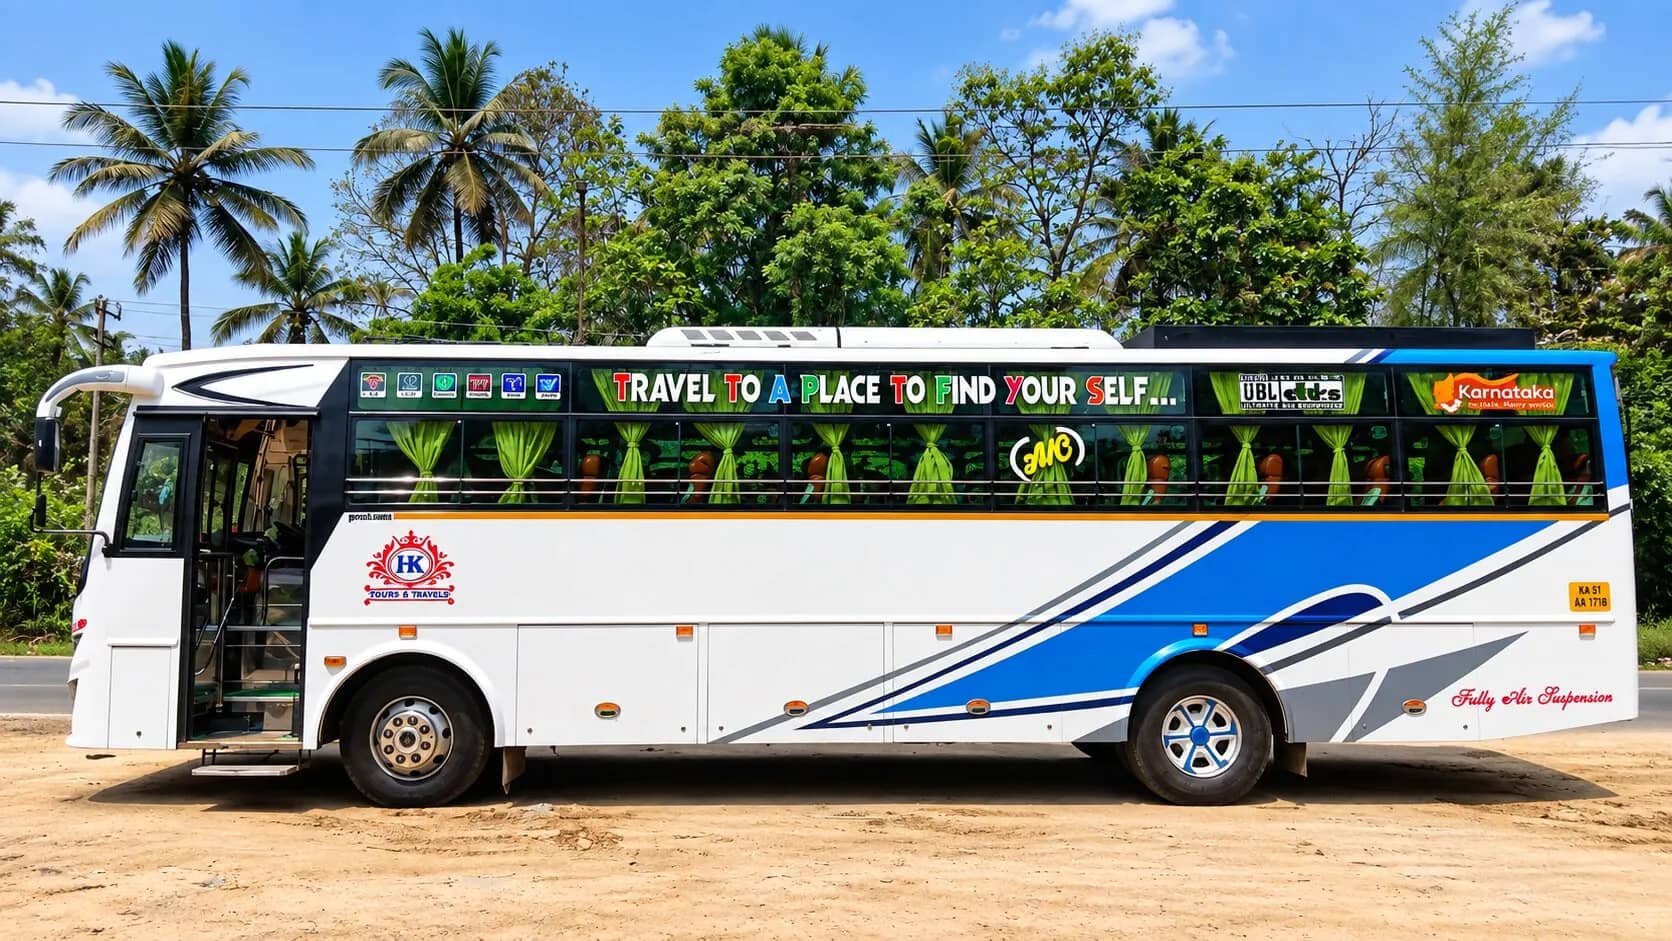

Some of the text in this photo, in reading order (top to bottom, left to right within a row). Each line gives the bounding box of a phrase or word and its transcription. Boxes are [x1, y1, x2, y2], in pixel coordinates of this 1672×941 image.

[613, 372, 716, 403] TRAVEL
[724, 374, 761, 404] TO
[768, 374, 792, 404] A
[800, 374, 880, 404] PLACE
[890, 374, 926, 404] TO
[935, 375, 996, 405] FIND
[1004, 375, 1077, 405] YOUR
[1243, 382, 1278, 401] UBL
[1458, 384, 1554, 399] Karnataka
[396, 555, 425, 573] HK
[1578, 585, 1601, 595] KA 51
[1574, 597, 1587, 608] AA
[1451, 686, 1613, 712] Fully Air Suspension
